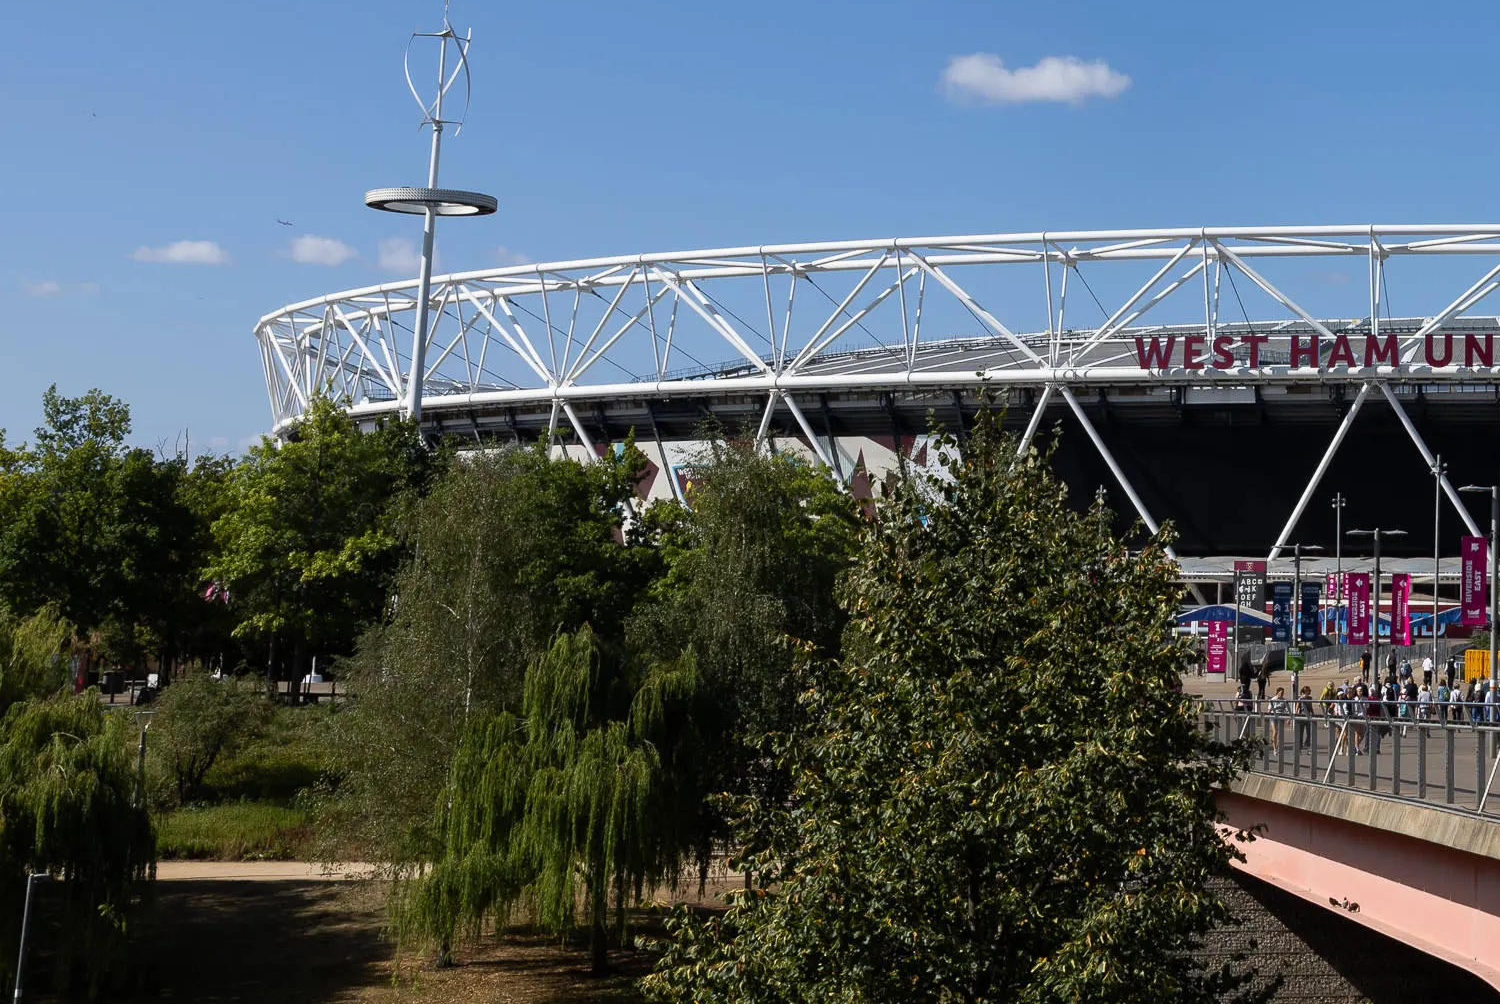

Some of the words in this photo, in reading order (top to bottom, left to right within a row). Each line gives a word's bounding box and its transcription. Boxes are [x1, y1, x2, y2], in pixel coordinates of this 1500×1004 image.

[1134, 336, 1269, 370] WEST
[1290, 334, 1400, 369] HAM
[1465, 560, 1473, 603] RIVERSIDE
[1474, 571, 1482, 591] EAST
